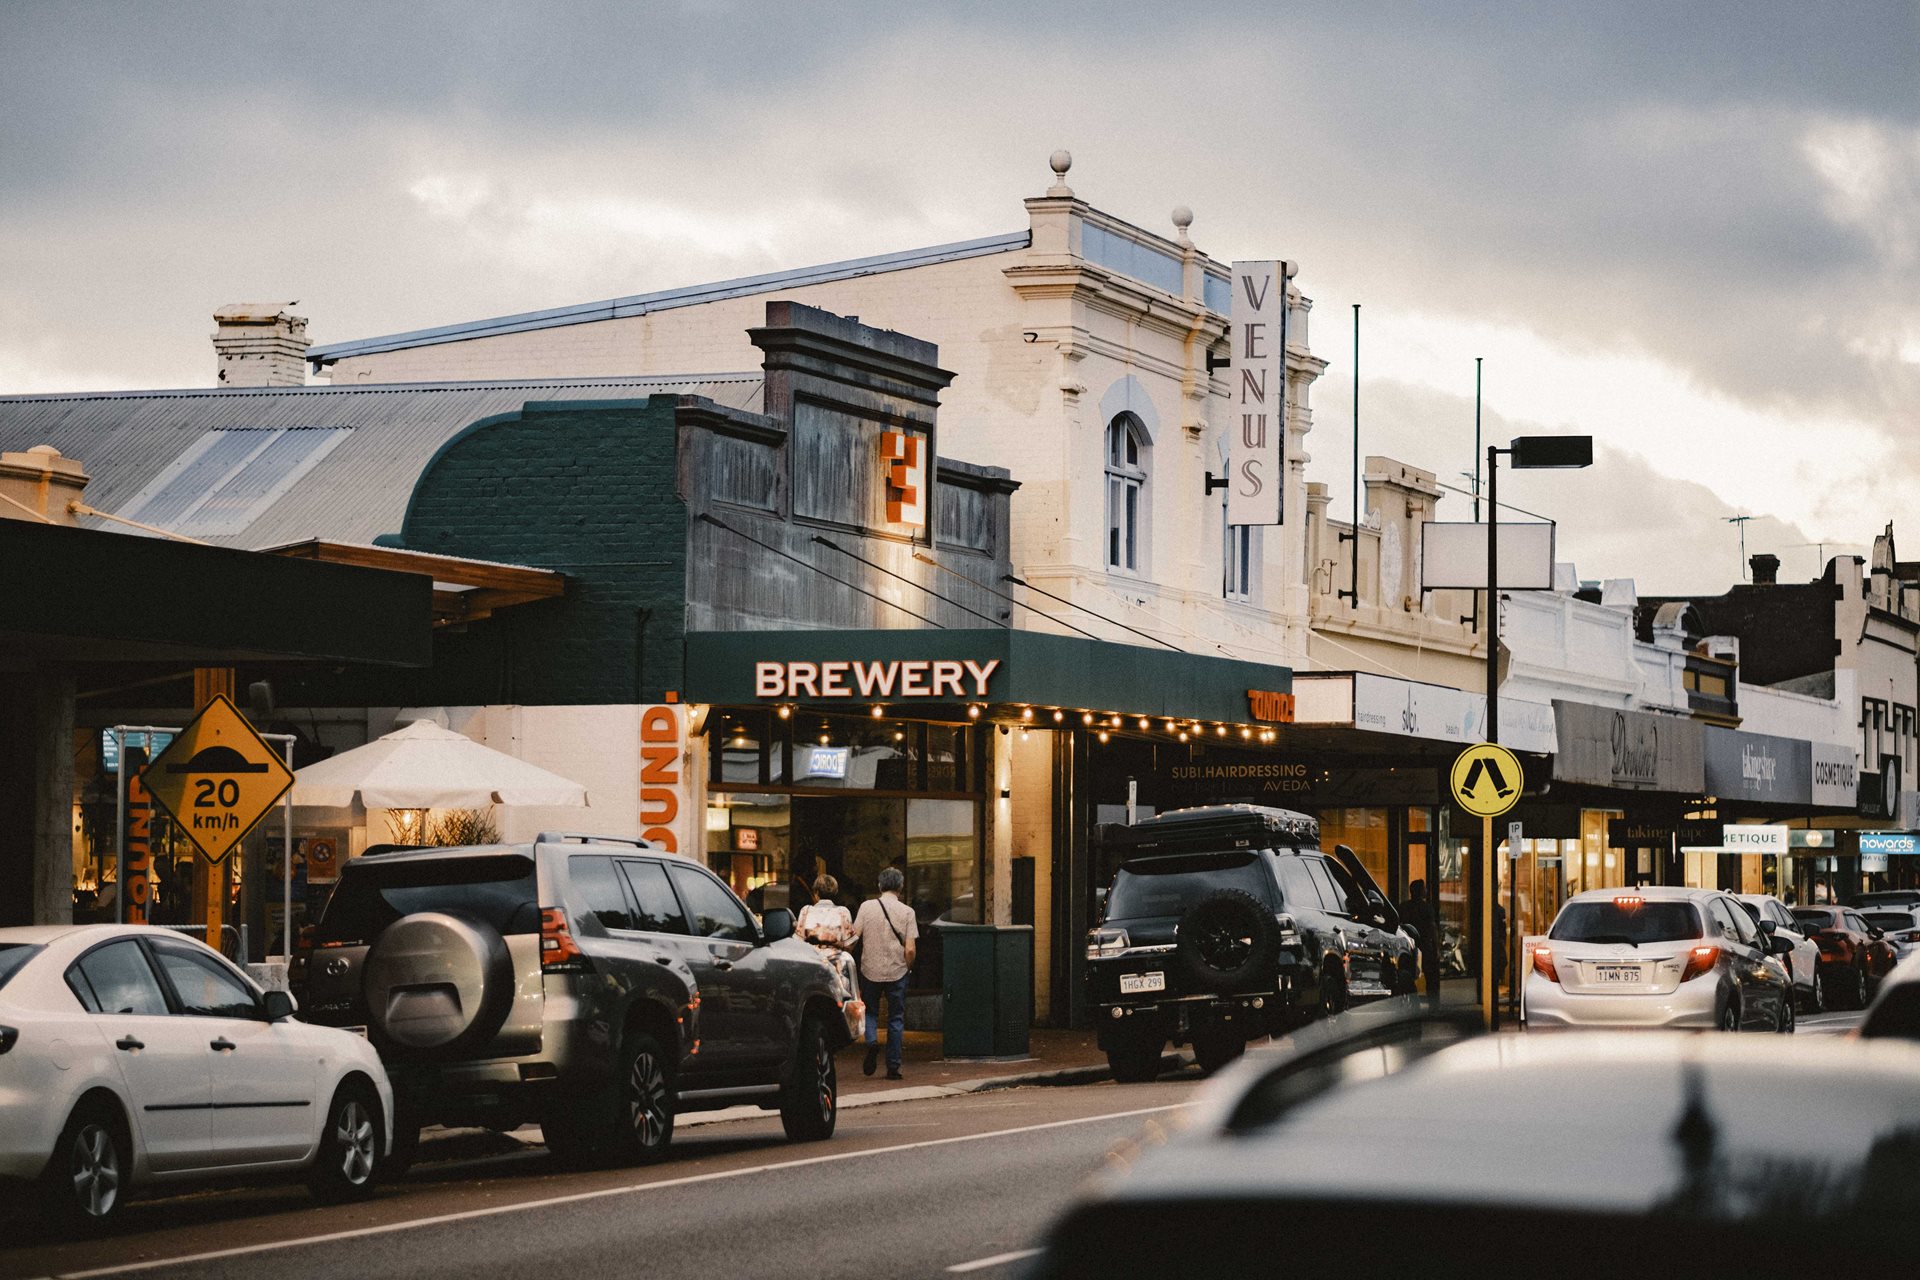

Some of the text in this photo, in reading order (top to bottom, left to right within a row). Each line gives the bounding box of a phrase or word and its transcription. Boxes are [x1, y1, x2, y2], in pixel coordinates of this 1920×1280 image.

[1239, 275, 1270, 498] VENUS
[755, 659, 1000, 697] BREWERY
[1357, 709, 1386, 728] hairdressing
[640, 690, 679, 854] OUND.
[1815, 761, 1854, 791] COSMETIQUE
[194, 778, 240, 808] 20
[1263, 779, 1311, 792] AVEDA
[193, 812, 239, 832] km/h
[1511, 824, 1520, 833] 1P
[1723, 833, 1777, 844] METIQUE
[1859, 835, 1914, 849] howards
[1148, 977, 1162, 988] 299
[1624, 969, 1639, 982] 875
